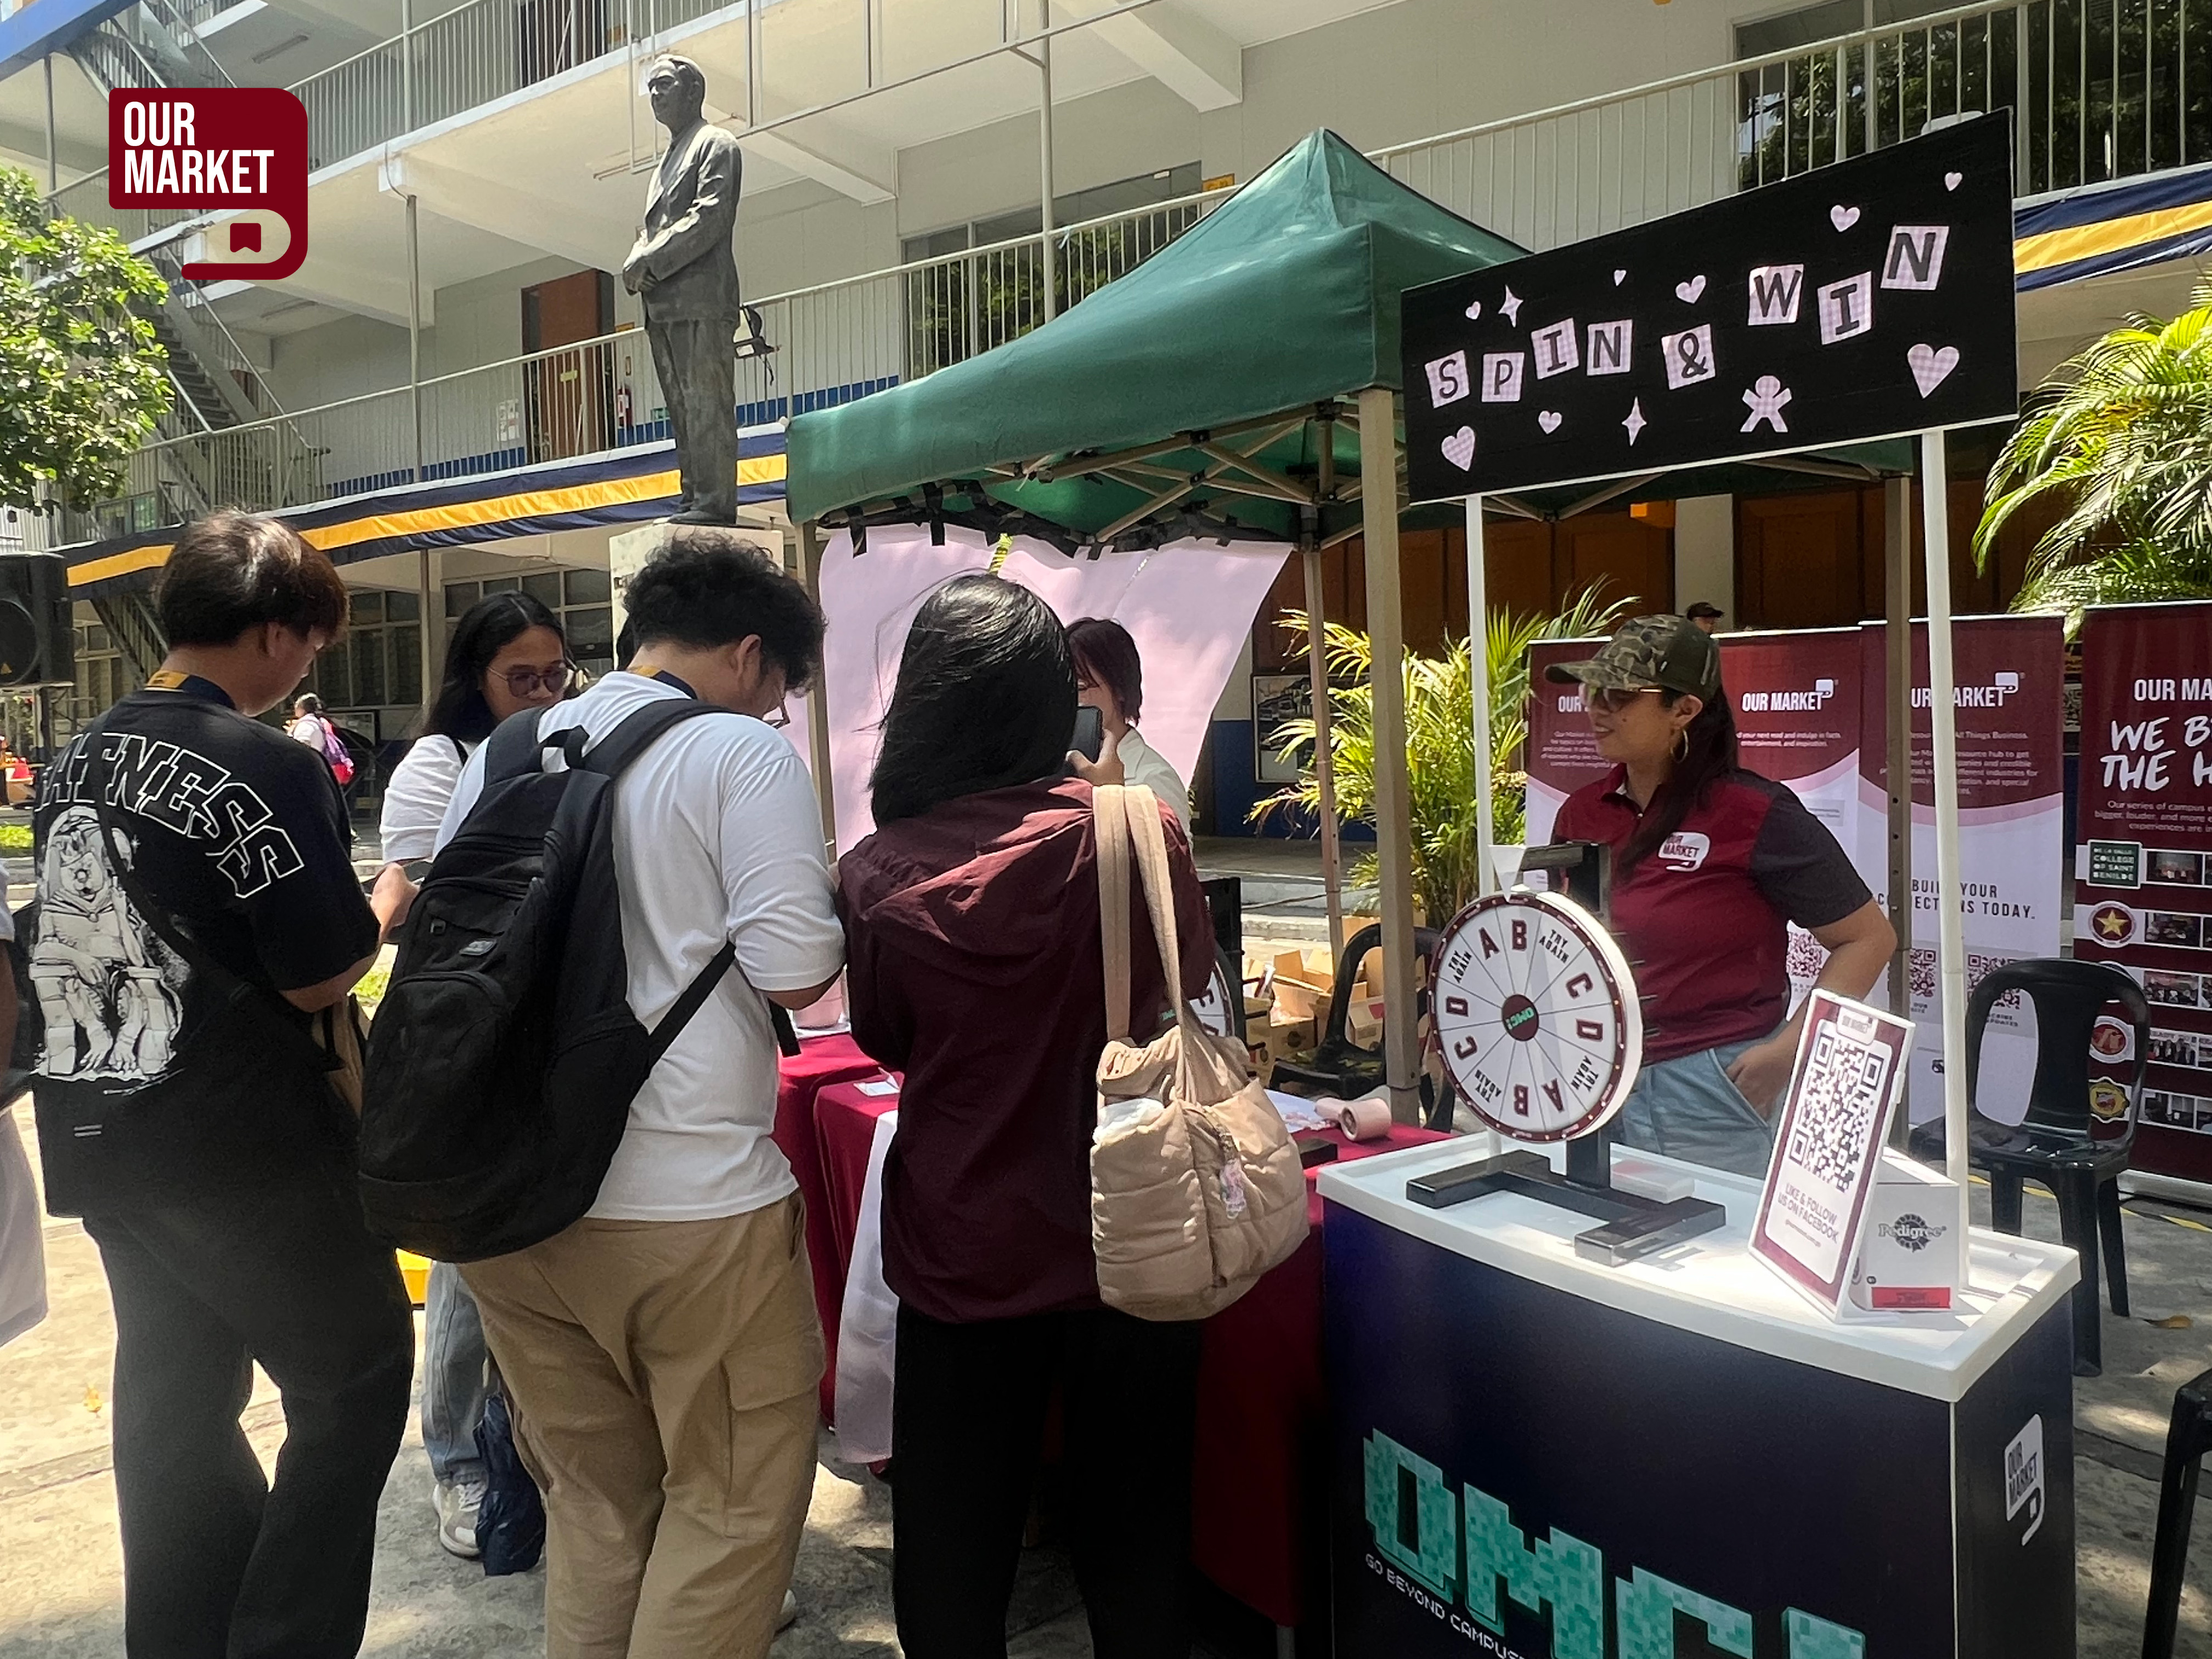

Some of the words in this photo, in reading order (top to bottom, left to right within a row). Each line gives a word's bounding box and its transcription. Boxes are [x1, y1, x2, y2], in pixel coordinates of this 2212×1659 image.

[1438, 326, 1622, 399] SPIN
[1681, 332, 1708, 378] &
[1754, 231, 1936, 336] WIN
[1742, 692, 1769, 712] OUR
[1770, 692, 1822, 710] MARKET
[1911, 688, 1932, 707] UR
[1954, 687, 2006, 707] ARKET
[2134, 679, 2176, 701] OUR
[1559, 696, 1582, 712] OUR
[2111, 716, 2170, 752] WE
[2184, 715, 2212, 747] B
[2100, 749, 2177, 791] THE
[2107, 800, 2125, 808] Our
[1663, 844, 1700, 857] MARKET
[1960, 882, 1997, 898] YOUR
[1982, 902, 2035, 919] TODAY.
[1479, 927, 1499, 960] A
[1511, 919, 1527, 951] B
[1551, 929, 1568, 948] TRY
[1448, 950, 1462, 970] TRY
[1539, 935, 1569, 964] AGAIN
[1453, 951, 1472, 984] AGAIN
[1566, 972, 1593, 998] C
[1445, 996, 1469, 1017] D
[1576, 1019, 1604, 1042] D
[1454, 1035, 1478, 1059] C
[1514, 1084, 1528, 1117] B
[1541, 1078, 1565, 1113] A
[1785, 1183, 1800, 1200] LIKE
[1799, 1193, 1805, 1205] &
[1807, 1197, 1837, 1225] FOLLOW
[1778, 1192, 1787, 1206] US
[1787, 1200, 1798, 1215] ON
[1798, 1207, 1838, 1244] FACEBOOK
[1365, 1554, 1383, 1575] GO
[1386, 1568, 1445, 1619] BEYOND
